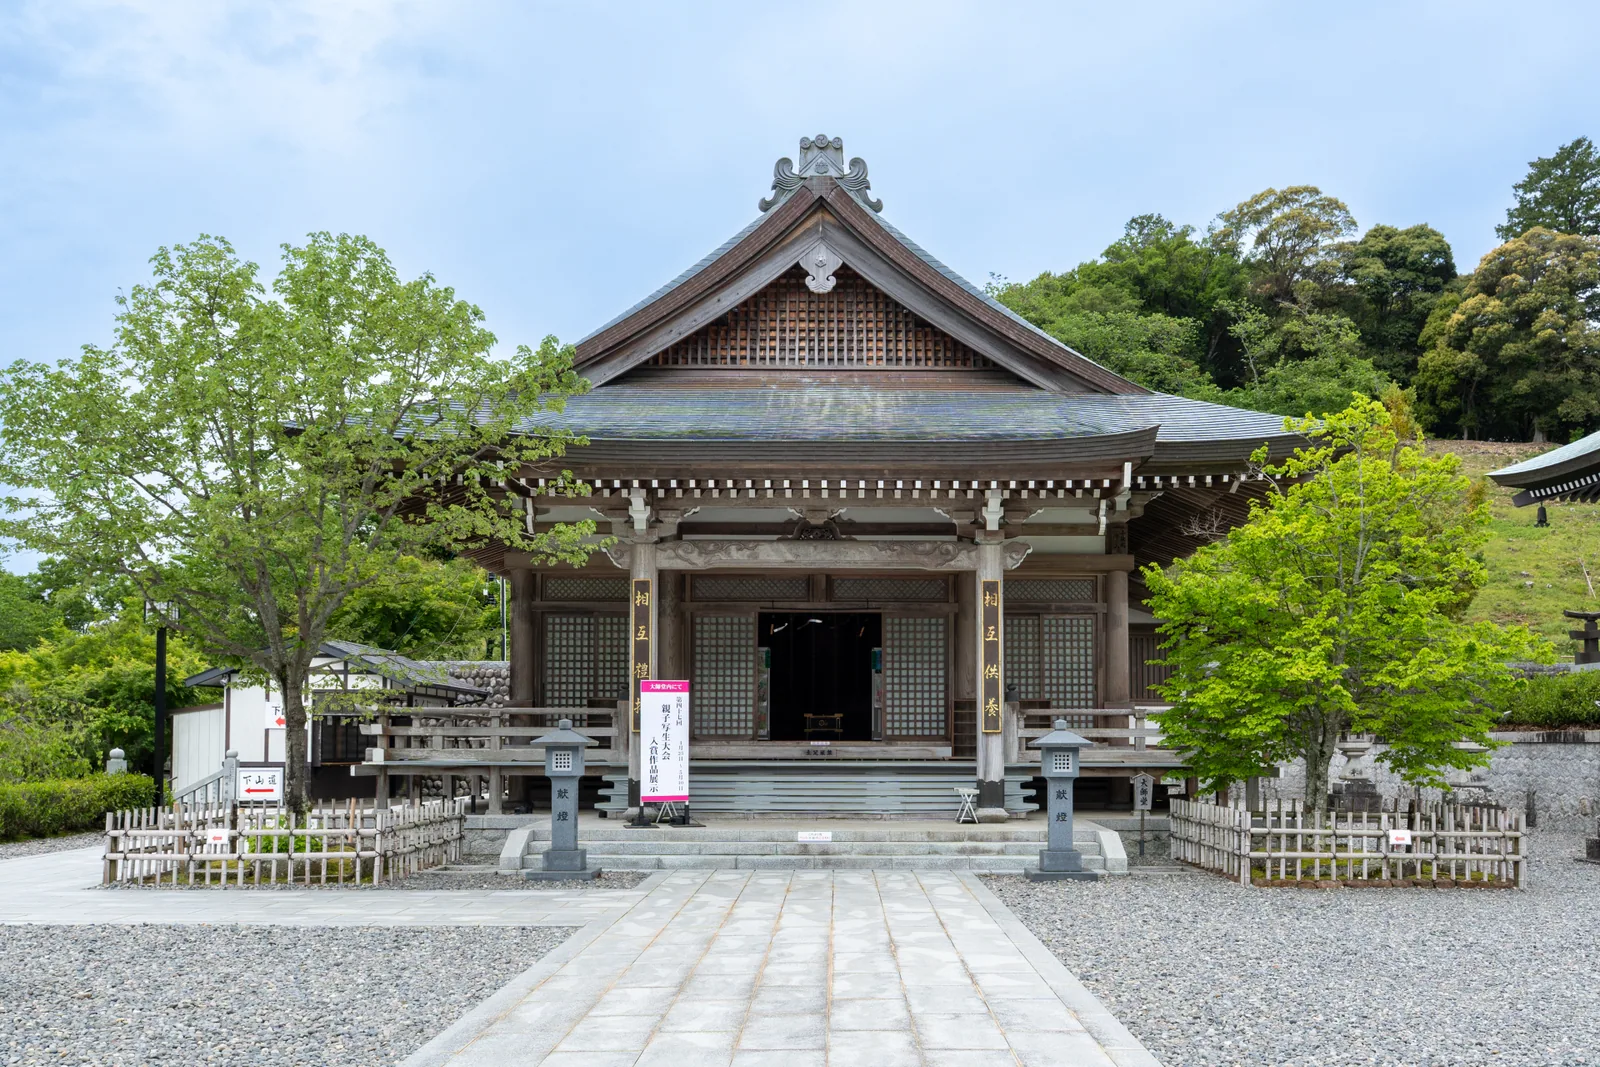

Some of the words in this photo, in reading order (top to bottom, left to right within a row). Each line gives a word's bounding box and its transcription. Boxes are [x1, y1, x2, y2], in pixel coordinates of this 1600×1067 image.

[984, 591, 999, 717] 相互供養
[662, 703, 671, 760] 親子写生大会
[243, 774, 277, 785] 下山道
[649, 736, 659, 793] 入賞作品展示
[1140, 777, 1149, 806] 大師堂
